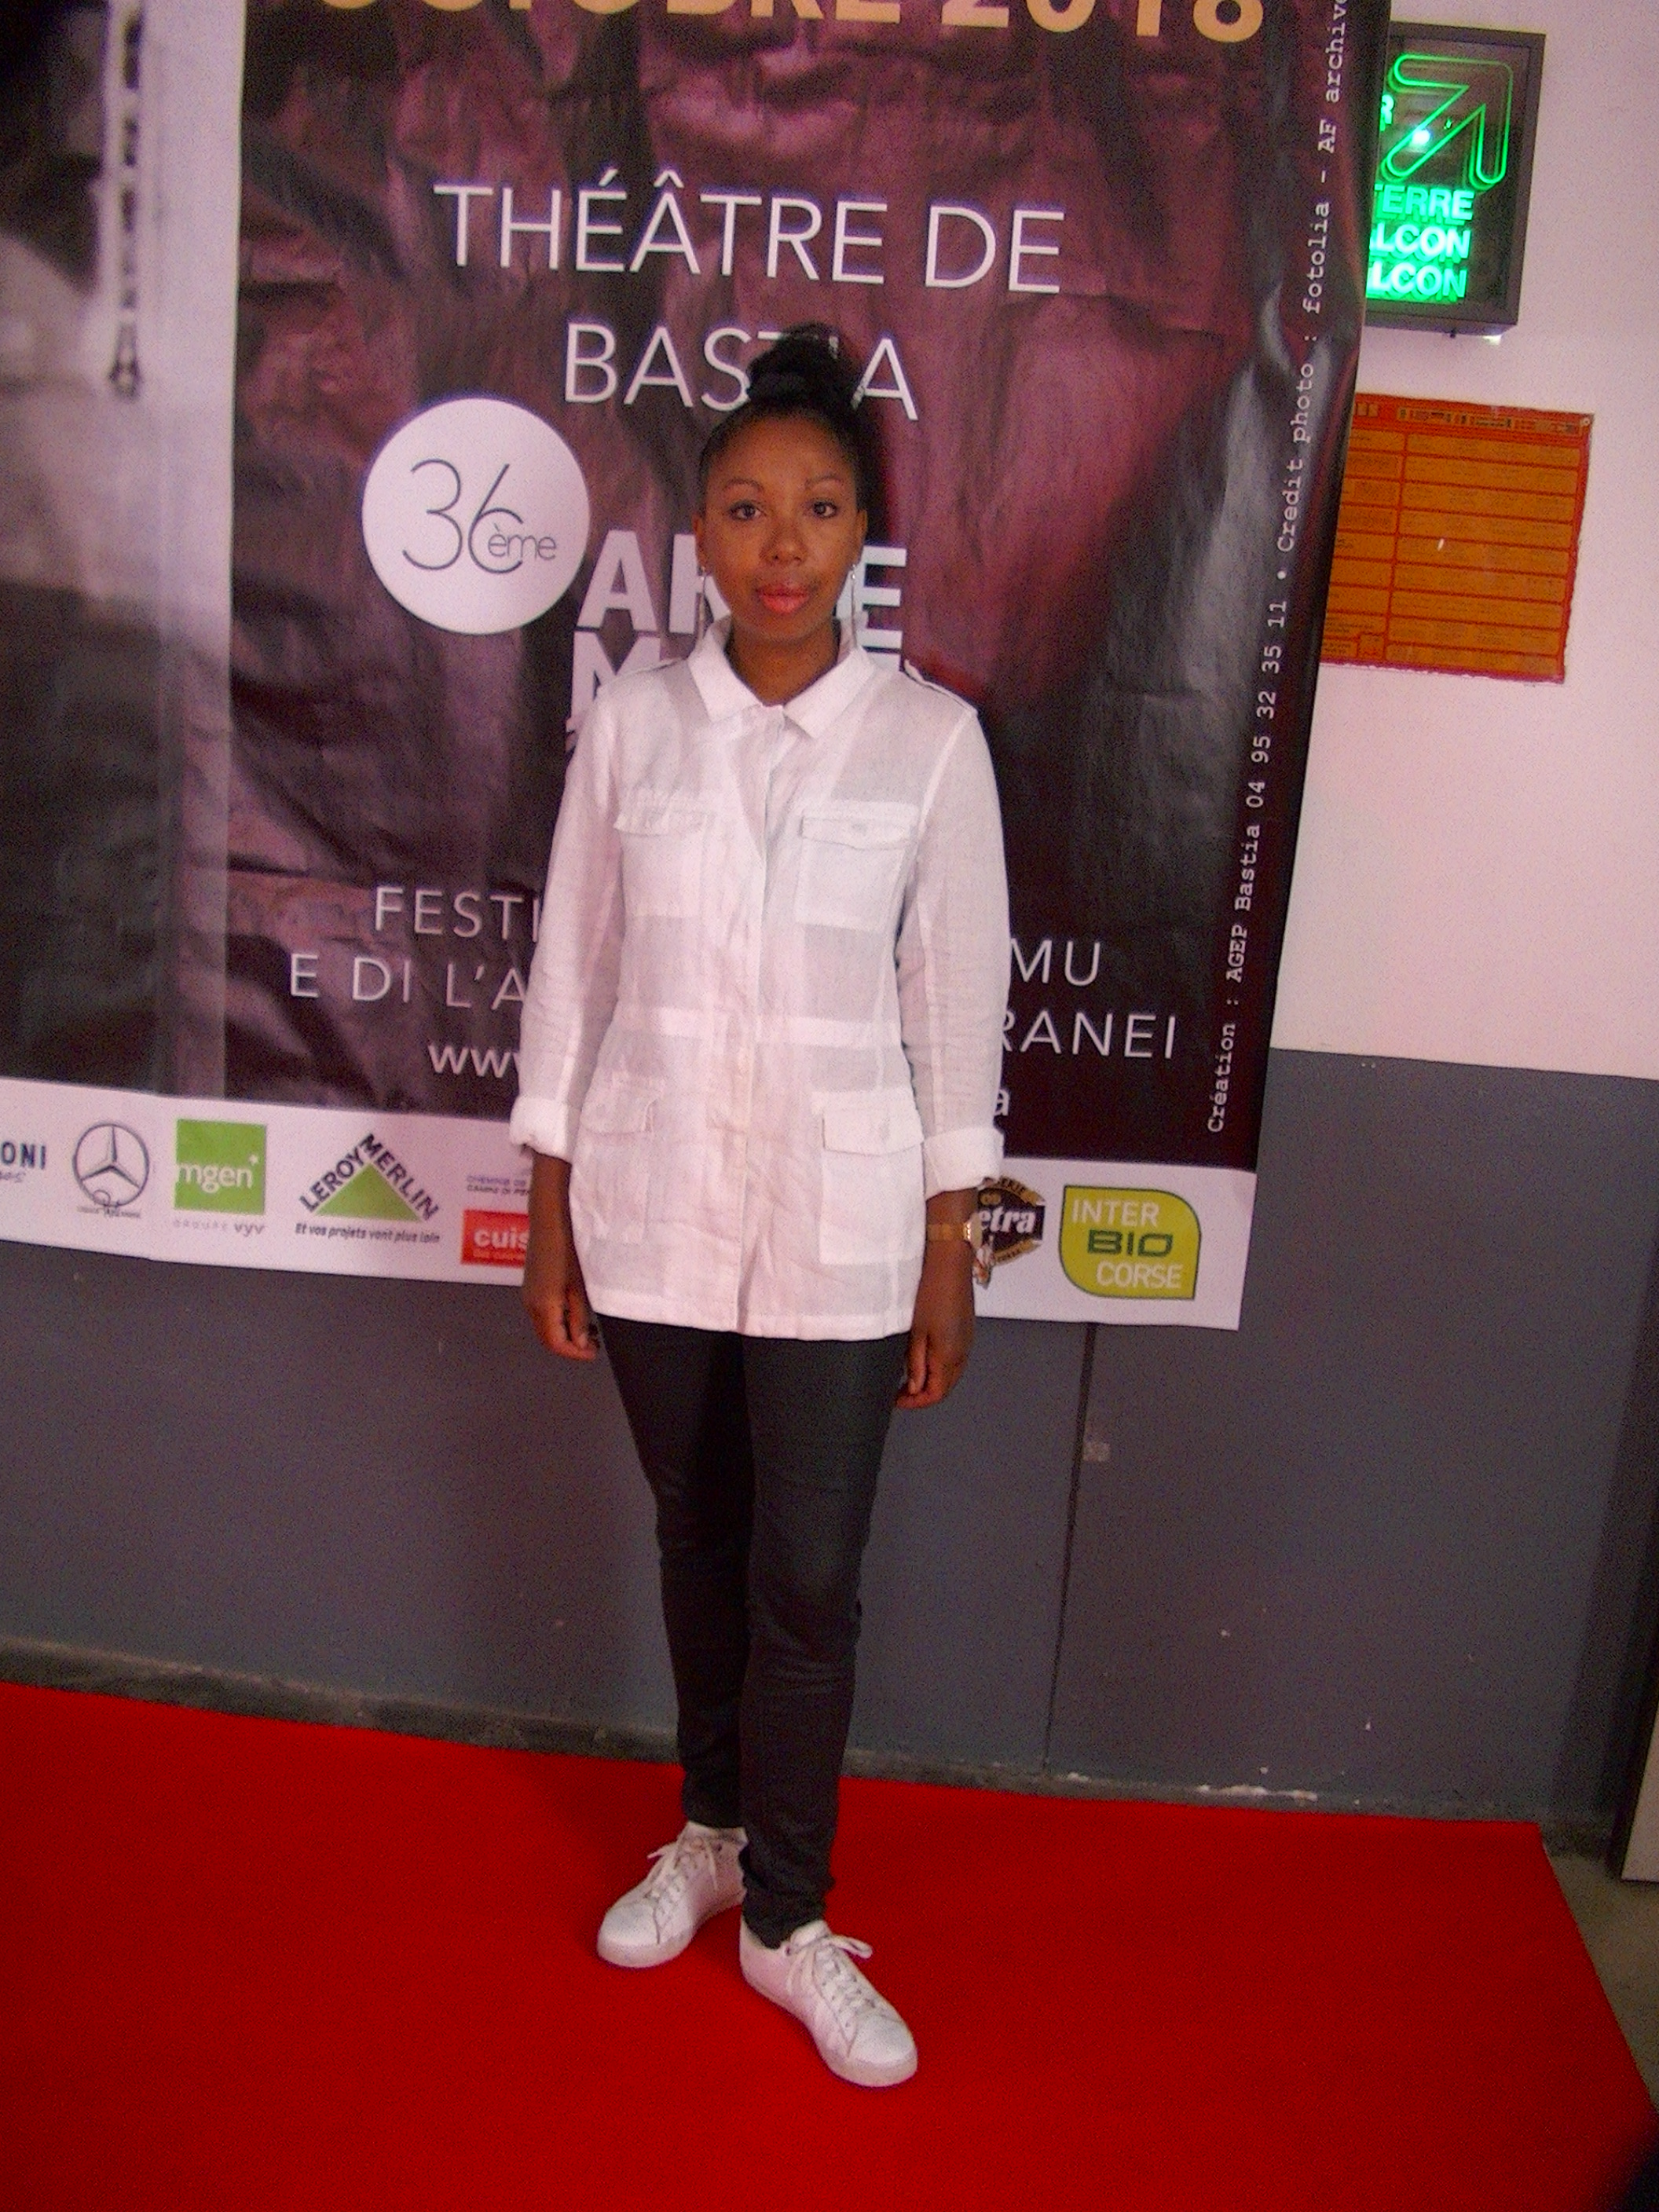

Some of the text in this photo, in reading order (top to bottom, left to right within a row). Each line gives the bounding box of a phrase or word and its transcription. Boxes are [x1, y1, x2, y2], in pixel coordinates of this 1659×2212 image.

[1318, 119, 1336, 155] AF
[433, 168, 1065, 295] THÉÂTRE DE
[1370, 222, 1471, 259] LCON
[1302, 201, 1330, 314] fotolia
[1367, 259, 1467, 298] LCON
[565, 322, 917, 421] BASA
[1290, 363, 1314, 443] photo
[1267, 600, 1287, 628] 11
[1262, 644, 1282, 674] 35
[1257, 690, 1277, 720] 32
[1251, 735, 1271, 764] 95
[1246, 781, 1265, 808] 04
[1235, 825, 1261, 912] Bastia
[375, 886, 540, 943] FESTI
[1010, 938, 1100, 987] MU
[1226, 925, 1247, 983] AGEP
[291, 953, 317, 998] E
[352, 957, 410, 1003] DI
[1002, 1009, 1176, 1060] RANEI
[1, 1141, 46, 1170] ONI
[177, 1161, 253, 1194] mgen
[298, 1146, 365, 1214] LEROY
[358, 1133, 439, 1221] MERLIN
[979, 1206, 1037, 1234] etra
[1071, 1199, 1159, 1228] INTER
[1088, 1229, 1173, 1257] BIO
[1096, 1262, 1181, 1288] CORSE
